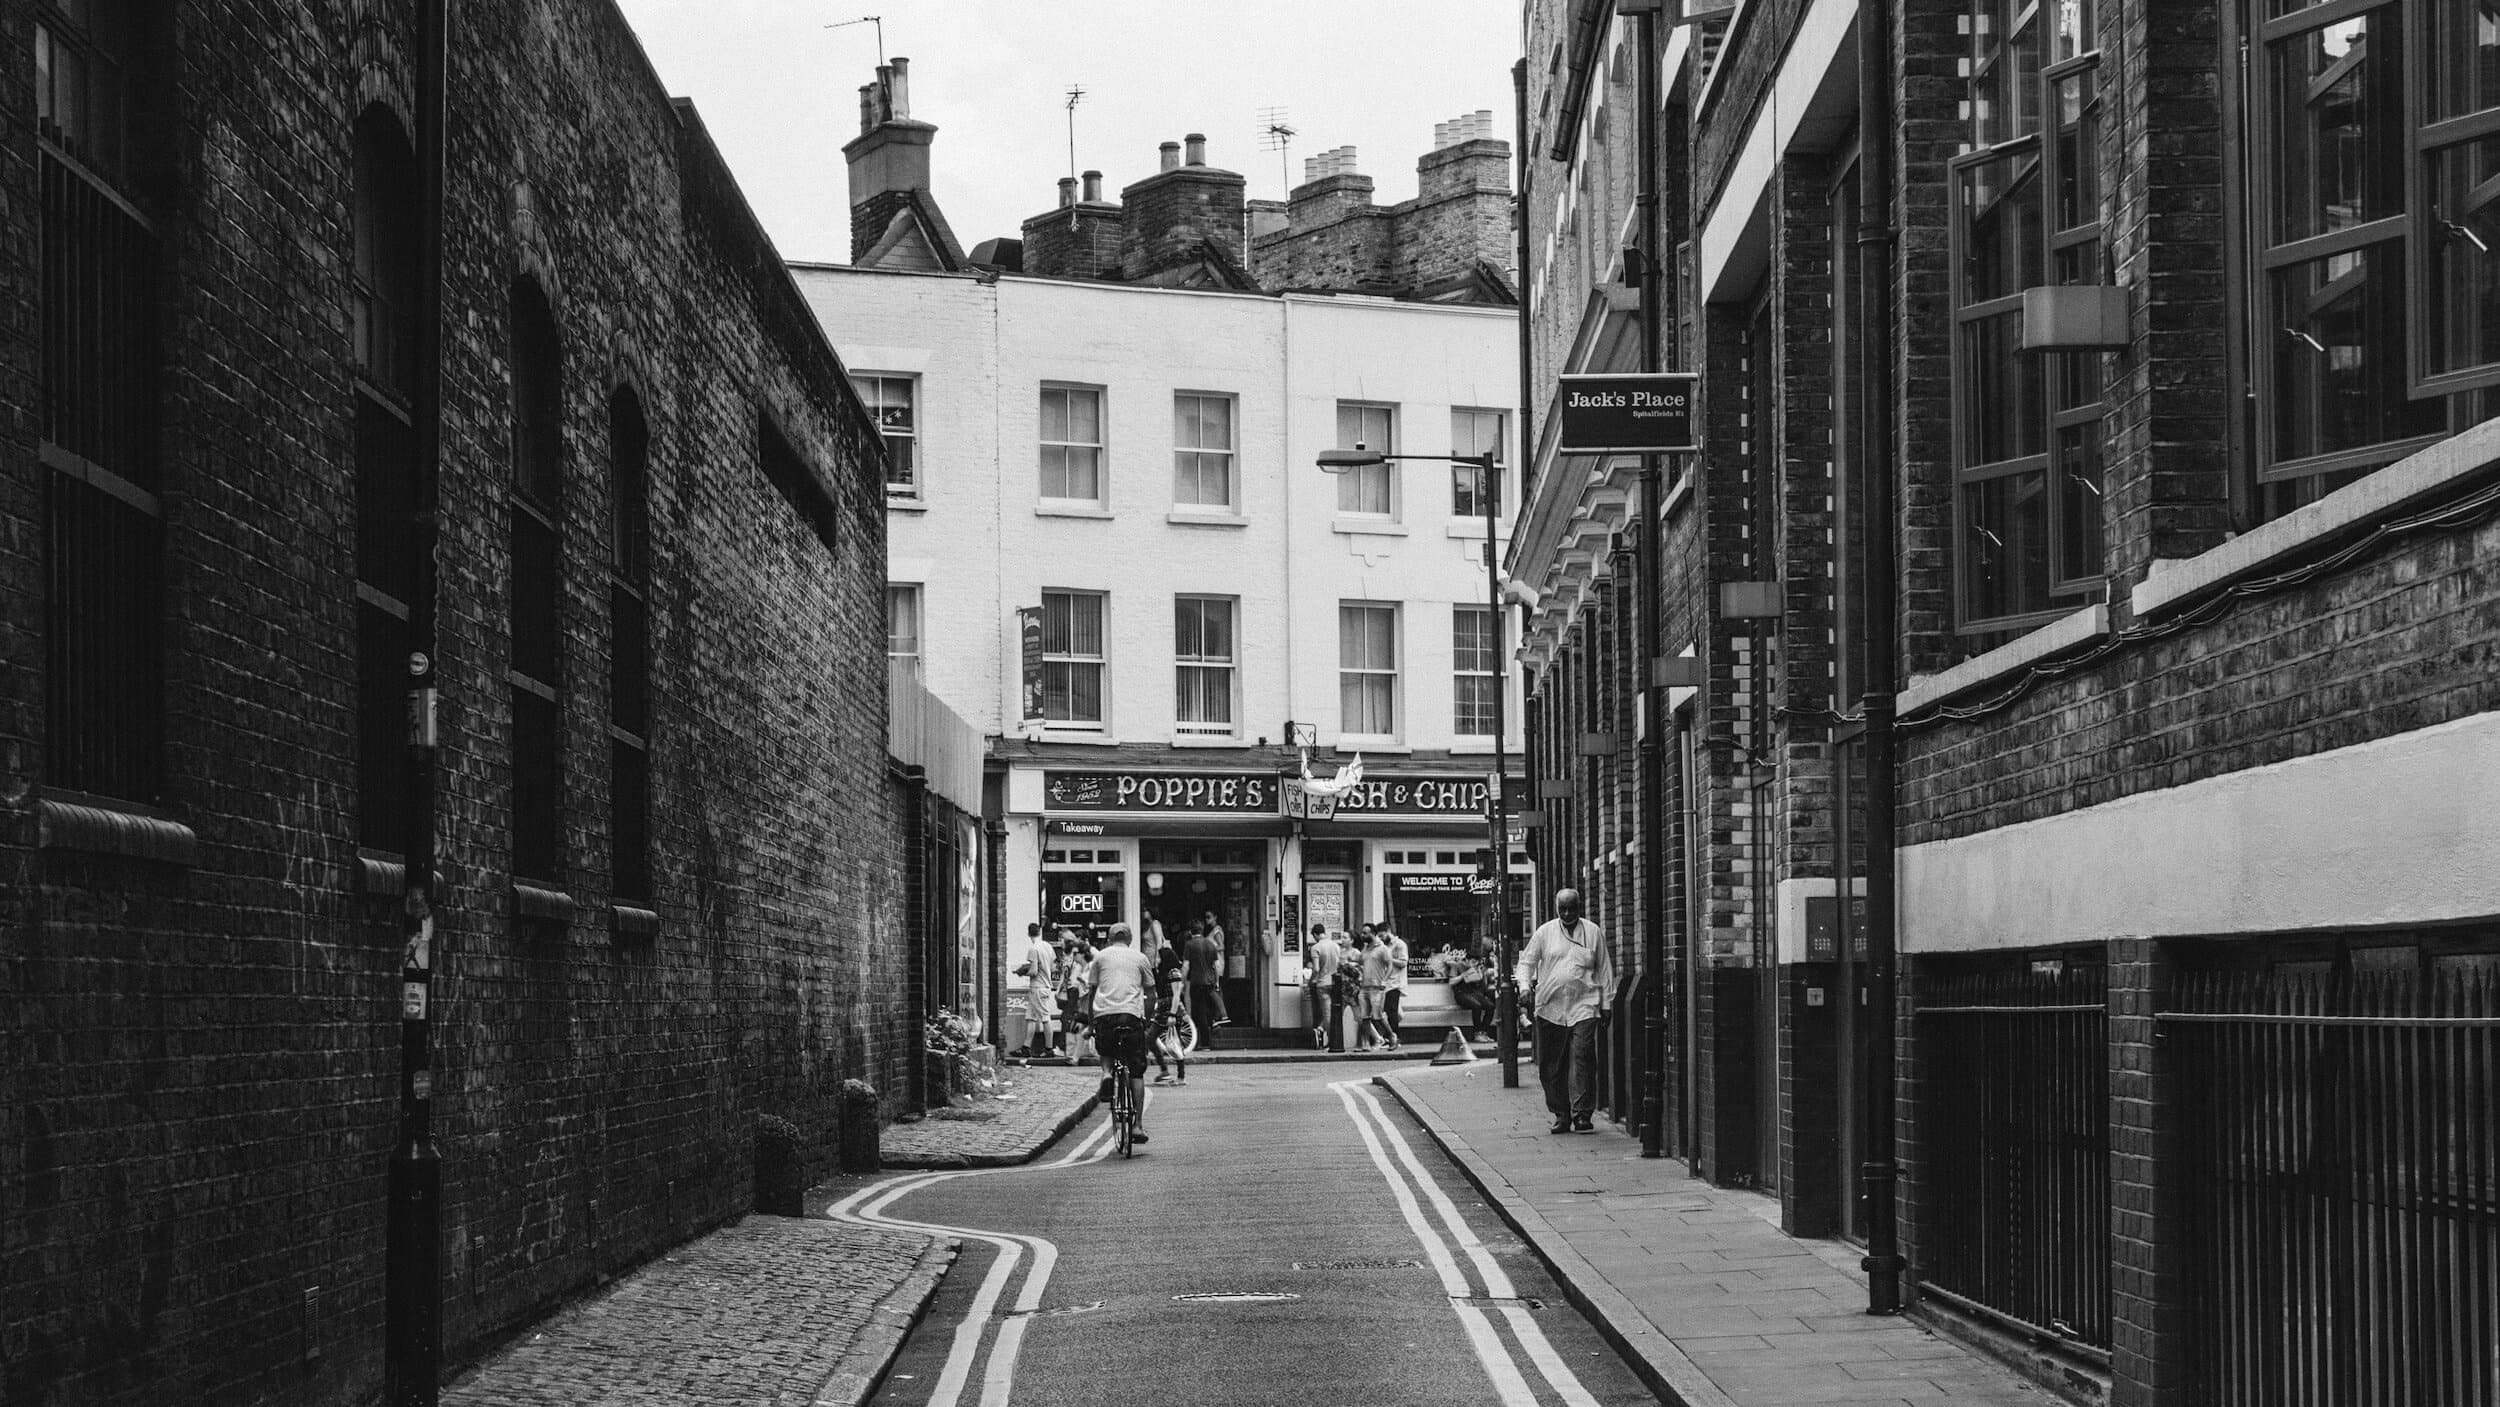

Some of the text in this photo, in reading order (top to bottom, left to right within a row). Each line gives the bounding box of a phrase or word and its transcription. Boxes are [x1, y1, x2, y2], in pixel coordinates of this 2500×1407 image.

[1569, 391, 1685, 408] Jack's Place
[1117, 775, 1263, 808] POPPIE'S
[1287, 784, 1303, 797] FISH
[1338, 781, 1392, 809] SH
[1394, 784, 1409, 804] &
[1413, 780, 1488, 810] CHIP
[1310, 803, 1331, 815] CHIPS
[1060, 822, 1104, 836] Takeaway
[1401, 876, 1463, 886] WELCOME TO
[1063, 895, 1102, 911] OPEN
